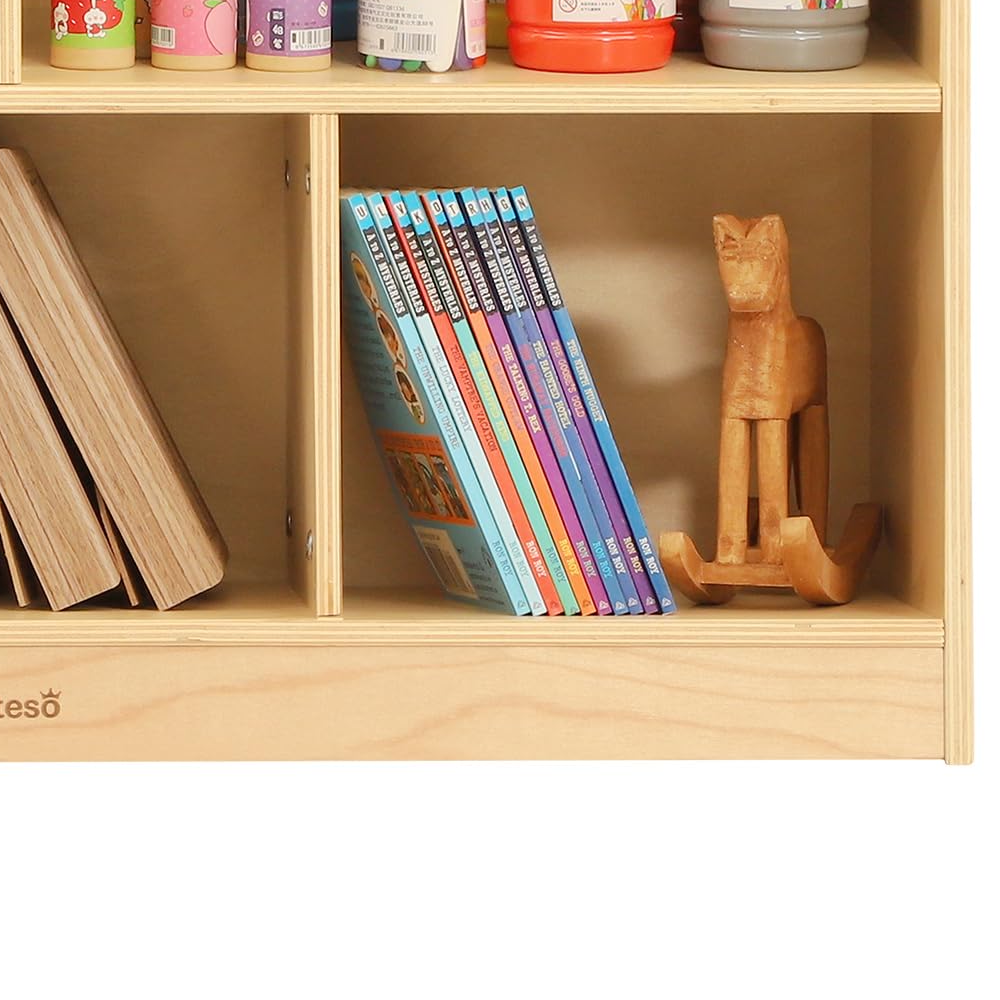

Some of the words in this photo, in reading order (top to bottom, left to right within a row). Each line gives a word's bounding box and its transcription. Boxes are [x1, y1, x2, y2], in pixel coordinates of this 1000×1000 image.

[481, 202, 490, 211] H
[501, 200, 509, 209] G
[519, 199, 527, 208] N
[357, 207, 365, 217] U
[396, 205, 404, 213] V
[449, 206, 457, 215] T
[468, 205, 476, 214] R
[415, 213, 423, 222] K
[441, 228, 450, 236] A
[489, 227, 499, 235] A
[508, 226, 518, 234] A
[525, 225, 535, 233] A
[366, 233, 376, 241] A
[386, 232, 396, 240] A
[405, 231, 414, 239] A
[457, 230, 467, 238] A
[476, 230, 485, 238] A
[422, 238, 432, 246] A
[448, 247, 458, 255] Z
[496, 246, 506, 254] Z
[515, 245, 525, 253] Z
[531, 244, 542, 252] Z
[374, 252, 384, 260] Z
[394, 251, 404, 259] Z
[412, 250, 422, 258] Z
[465, 250, 474, 258] Z
[483, 249, 493, 257] Z
[430, 257, 440, 265] Z
[452, 257, 478, 309] MYSTERIES
[500, 255, 526, 307] MYSTERIES
[519, 254, 545, 306] MYSTERIES
[536, 254, 561, 306] MYSTERIES
[378, 261, 405, 313] MYSTERIES
[398, 261, 424, 312] MYSTERIES
[416, 260, 443, 311] MYSTERIES
[468, 259, 495, 311] MYSTERIES
[487, 259, 513, 311] MYSTERIES
[434, 267, 461, 318] MYSTERIES
[501, 343, 514, 362] THE
[508, 363, 529, 401] TALKING
[523, 403, 532, 413] T.
[528, 414, 541, 433] REX
[532, 340, 545, 358] THE
[539, 359, 560, 399] HAUNTED
[554, 400, 571, 428] HOTEL
[525, 540, 538, 558] RON
[533, 559, 546, 577] ROY
[575, 540, 589, 558] RON
[583, 559, 596, 577] ROY
[605, 537, 618, 555] RON
[612, 555, 626, 574] ROY
[623, 535, 636, 554] RON
[630, 555, 643, 573] ROY
[638, 537, 652, 555] RON
[645, 556, 659, 574] ROY
